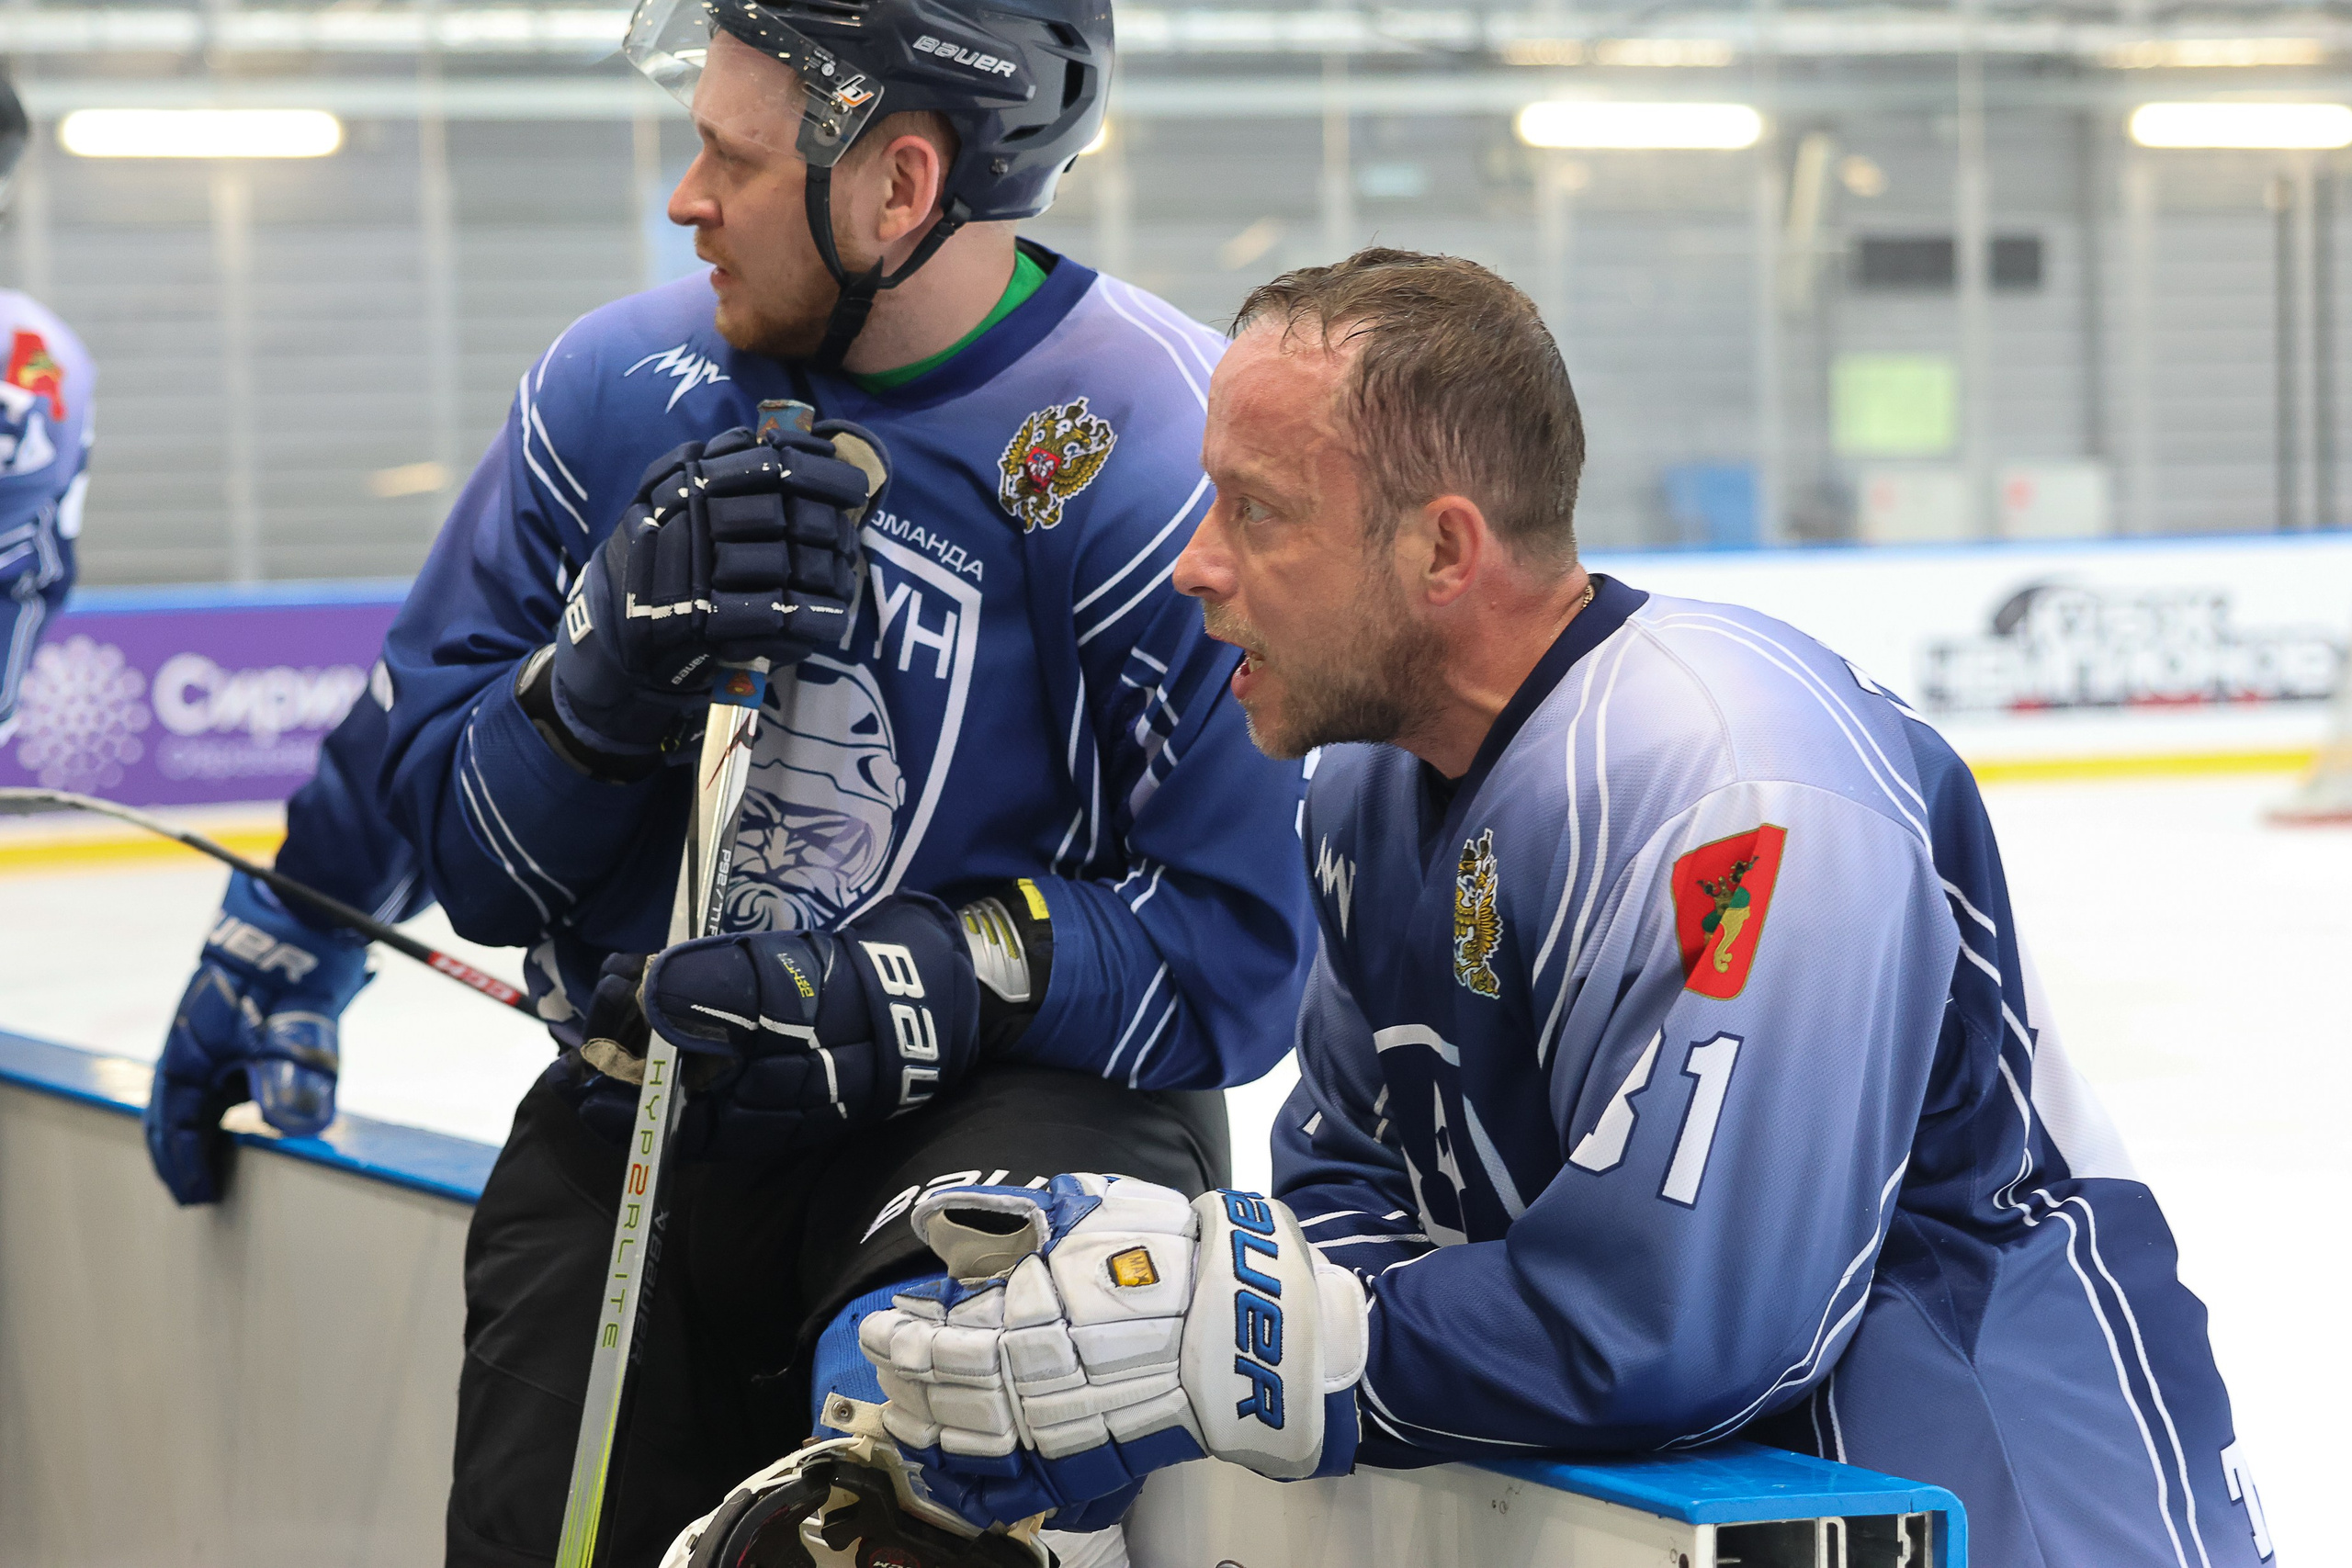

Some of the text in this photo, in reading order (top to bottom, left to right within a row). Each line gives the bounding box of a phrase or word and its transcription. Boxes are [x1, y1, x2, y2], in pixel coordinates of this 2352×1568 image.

[912, 35, 1017, 78] BAUER
[839, 563, 957, 679] УН
[1216, 1188, 1285, 1430] AUER
